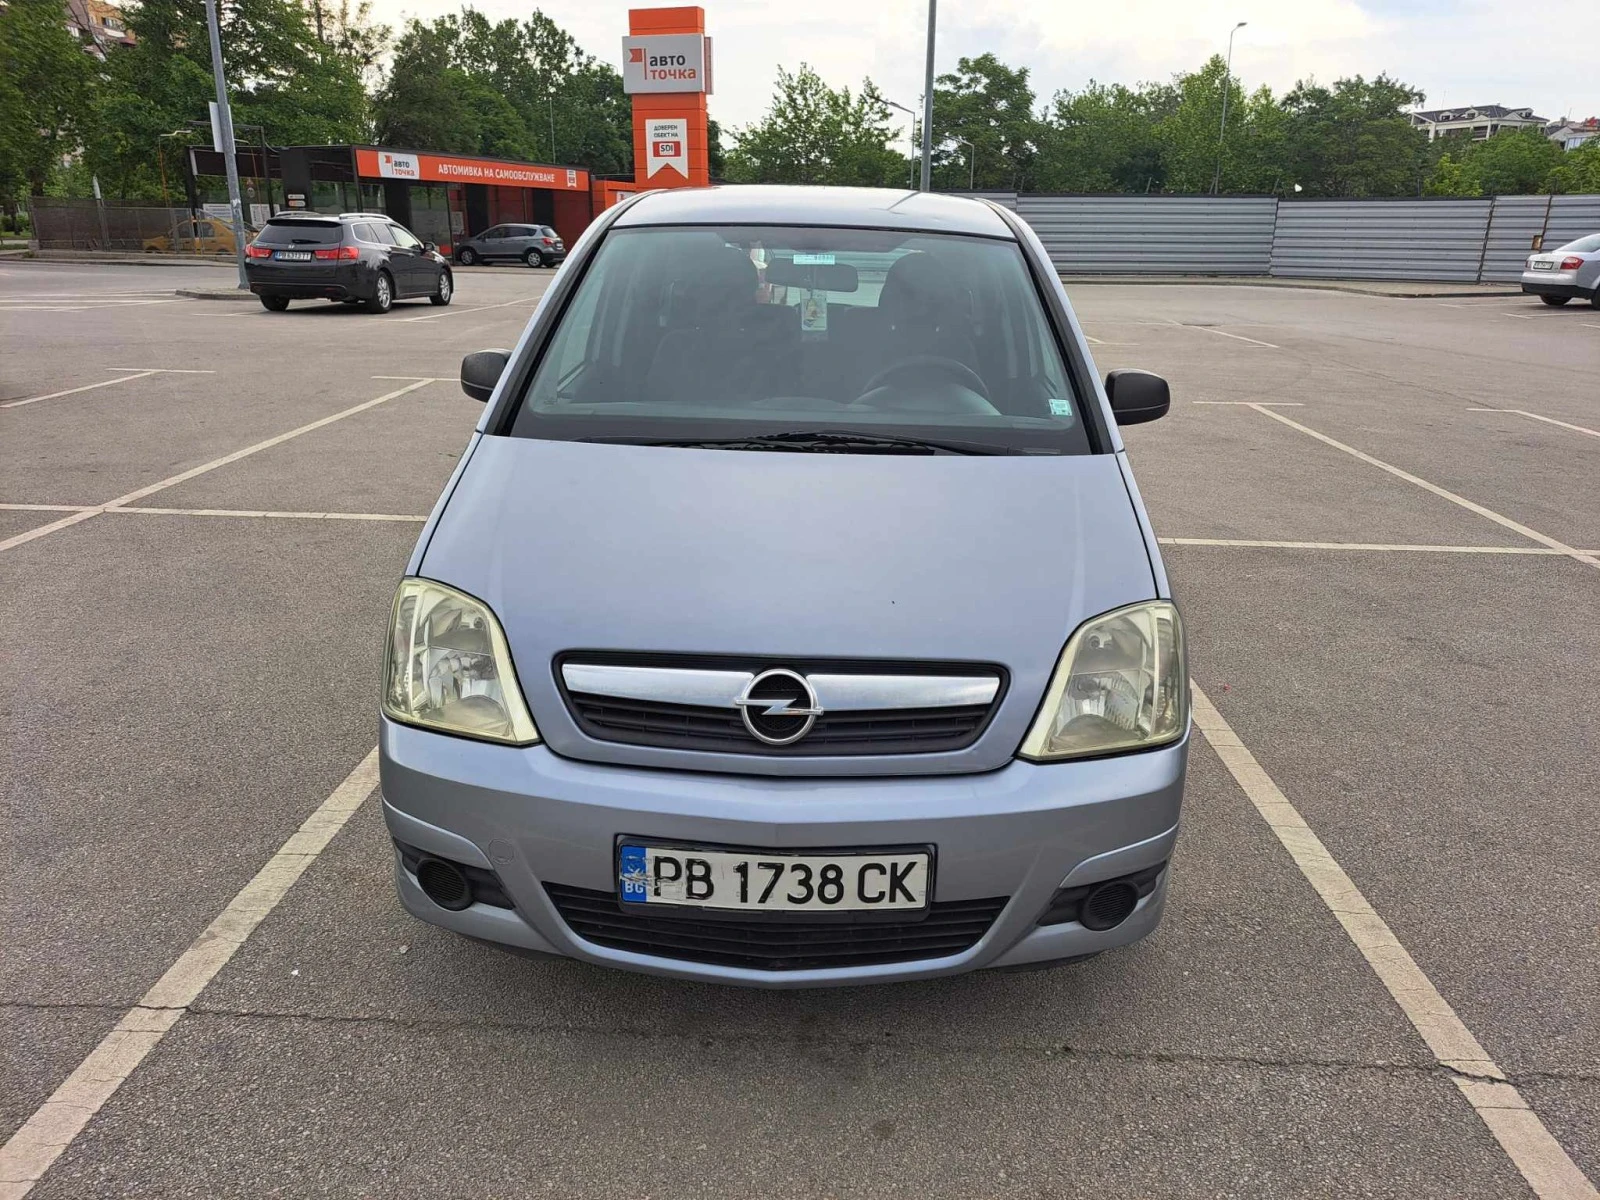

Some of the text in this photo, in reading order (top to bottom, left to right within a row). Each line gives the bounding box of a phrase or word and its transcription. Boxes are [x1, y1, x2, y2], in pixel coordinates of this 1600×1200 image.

[650, 55, 686, 66] авто
[650, 69, 696, 80] точка
[394, 160, 410, 168] авто
[438, 164, 483, 177] АВТОМИВКА
[484, 168, 494, 178] НА
[495, 168, 555, 182] САМООБСЛУЖВАНЕ
[653, 855, 918, 905] PB 1738 CK
[625, 881, 645, 894] BG
